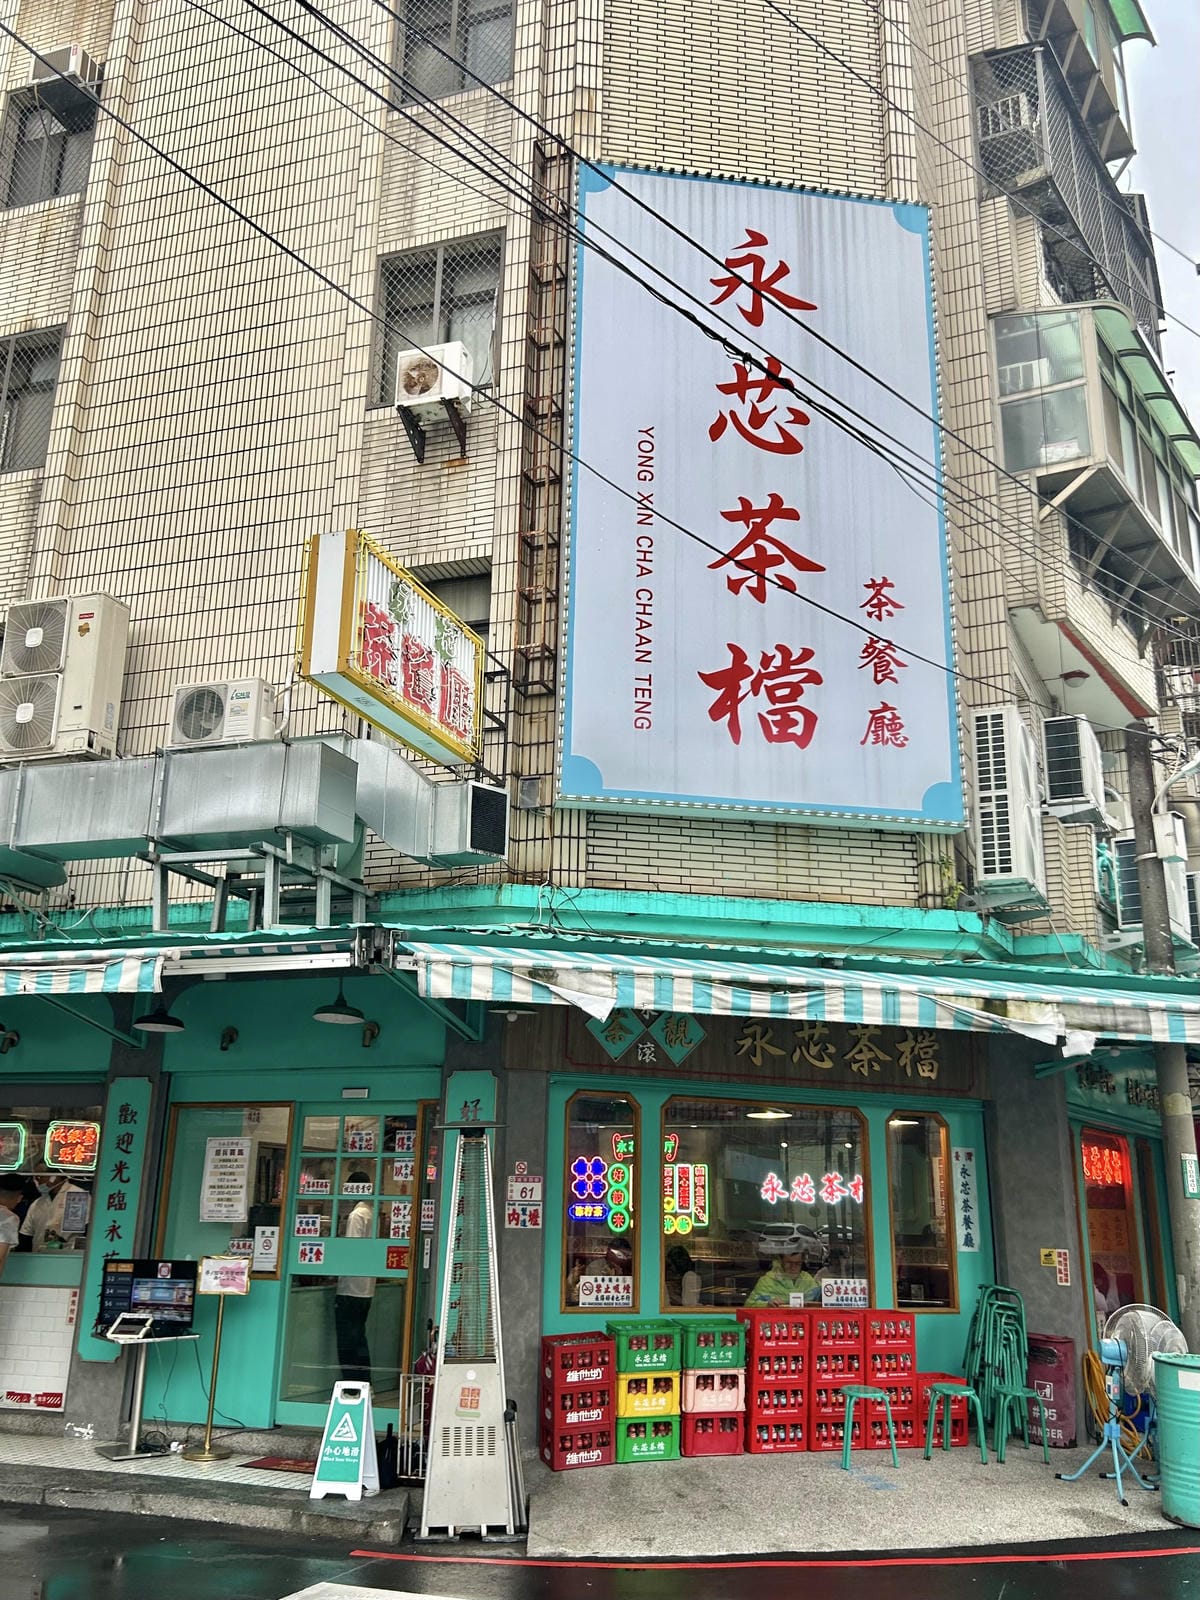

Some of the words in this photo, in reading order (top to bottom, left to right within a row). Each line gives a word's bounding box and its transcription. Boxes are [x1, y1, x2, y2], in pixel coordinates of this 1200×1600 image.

[637, 426, 654, 482] YONG
[636, 491, 654, 526] XIN
[699, 229, 825, 750] 永芯茶檔
[636, 536, 653, 578] CHA
[635, 588, 653, 663] CHAAN
[858, 577, 909, 749] 茶餐廳
[634, 674, 652, 730] TENG
[736, 1016, 941, 1080] 永芯茶檔
[520, 1186, 535, 1199] 61
[566, 1369, 602, 1382] 維他奶
[566, 1410, 602, 1424] 維他奶
[324, 1446, 360, 1457] 小心地滑
[566, 1450, 602, 1465] 維他奶
